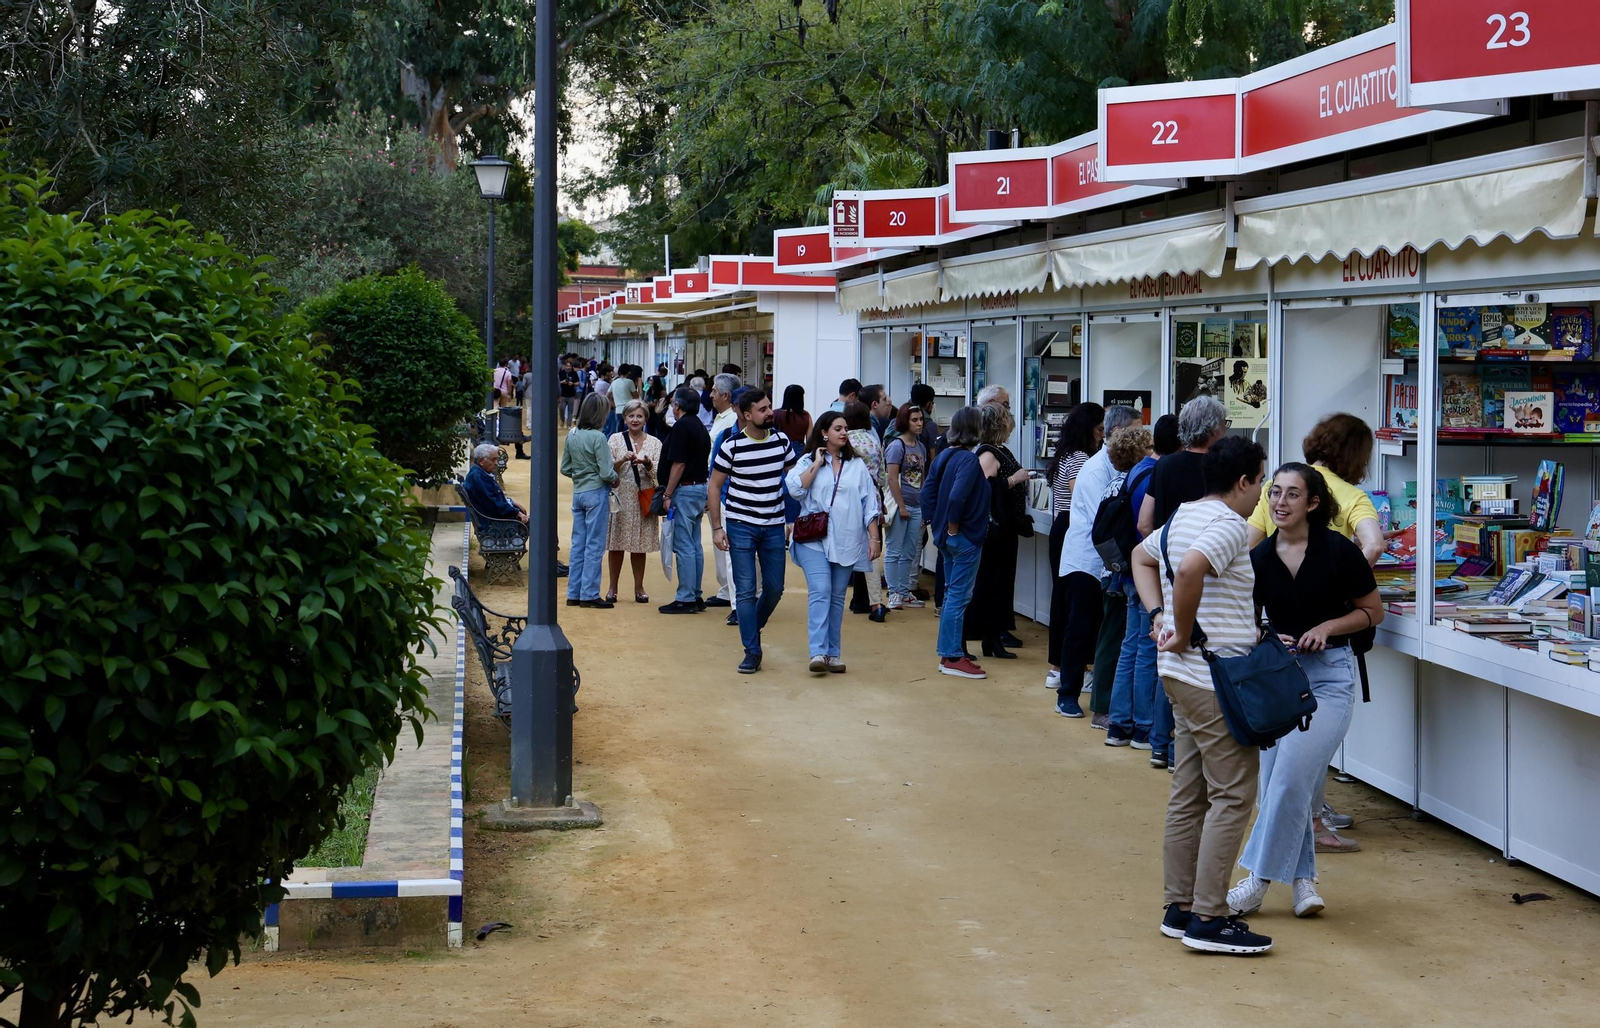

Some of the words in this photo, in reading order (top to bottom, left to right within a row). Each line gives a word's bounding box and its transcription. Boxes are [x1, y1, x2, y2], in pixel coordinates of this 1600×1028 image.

[1486, 12, 1531, 50] 23
[1320, 85, 1333, 118] EL
[1335, 64, 1398, 113] CUARTITO
[1152, 120, 1179, 145] 22
[996, 176, 1010, 195] 21
[1079, 166, 1086, 186] EL
[889, 211, 906, 226] 20
[797, 245, 805, 257] 19
[1343, 253, 1355, 282] EL
[1358, 246, 1418, 281] CUARTITO
[1130, 278, 1137, 298] EL
[1438, 317, 1467, 326] UNDO
[1394, 384, 1419, 410] PREGU
[1394, 510, 1415, 521] QUE
